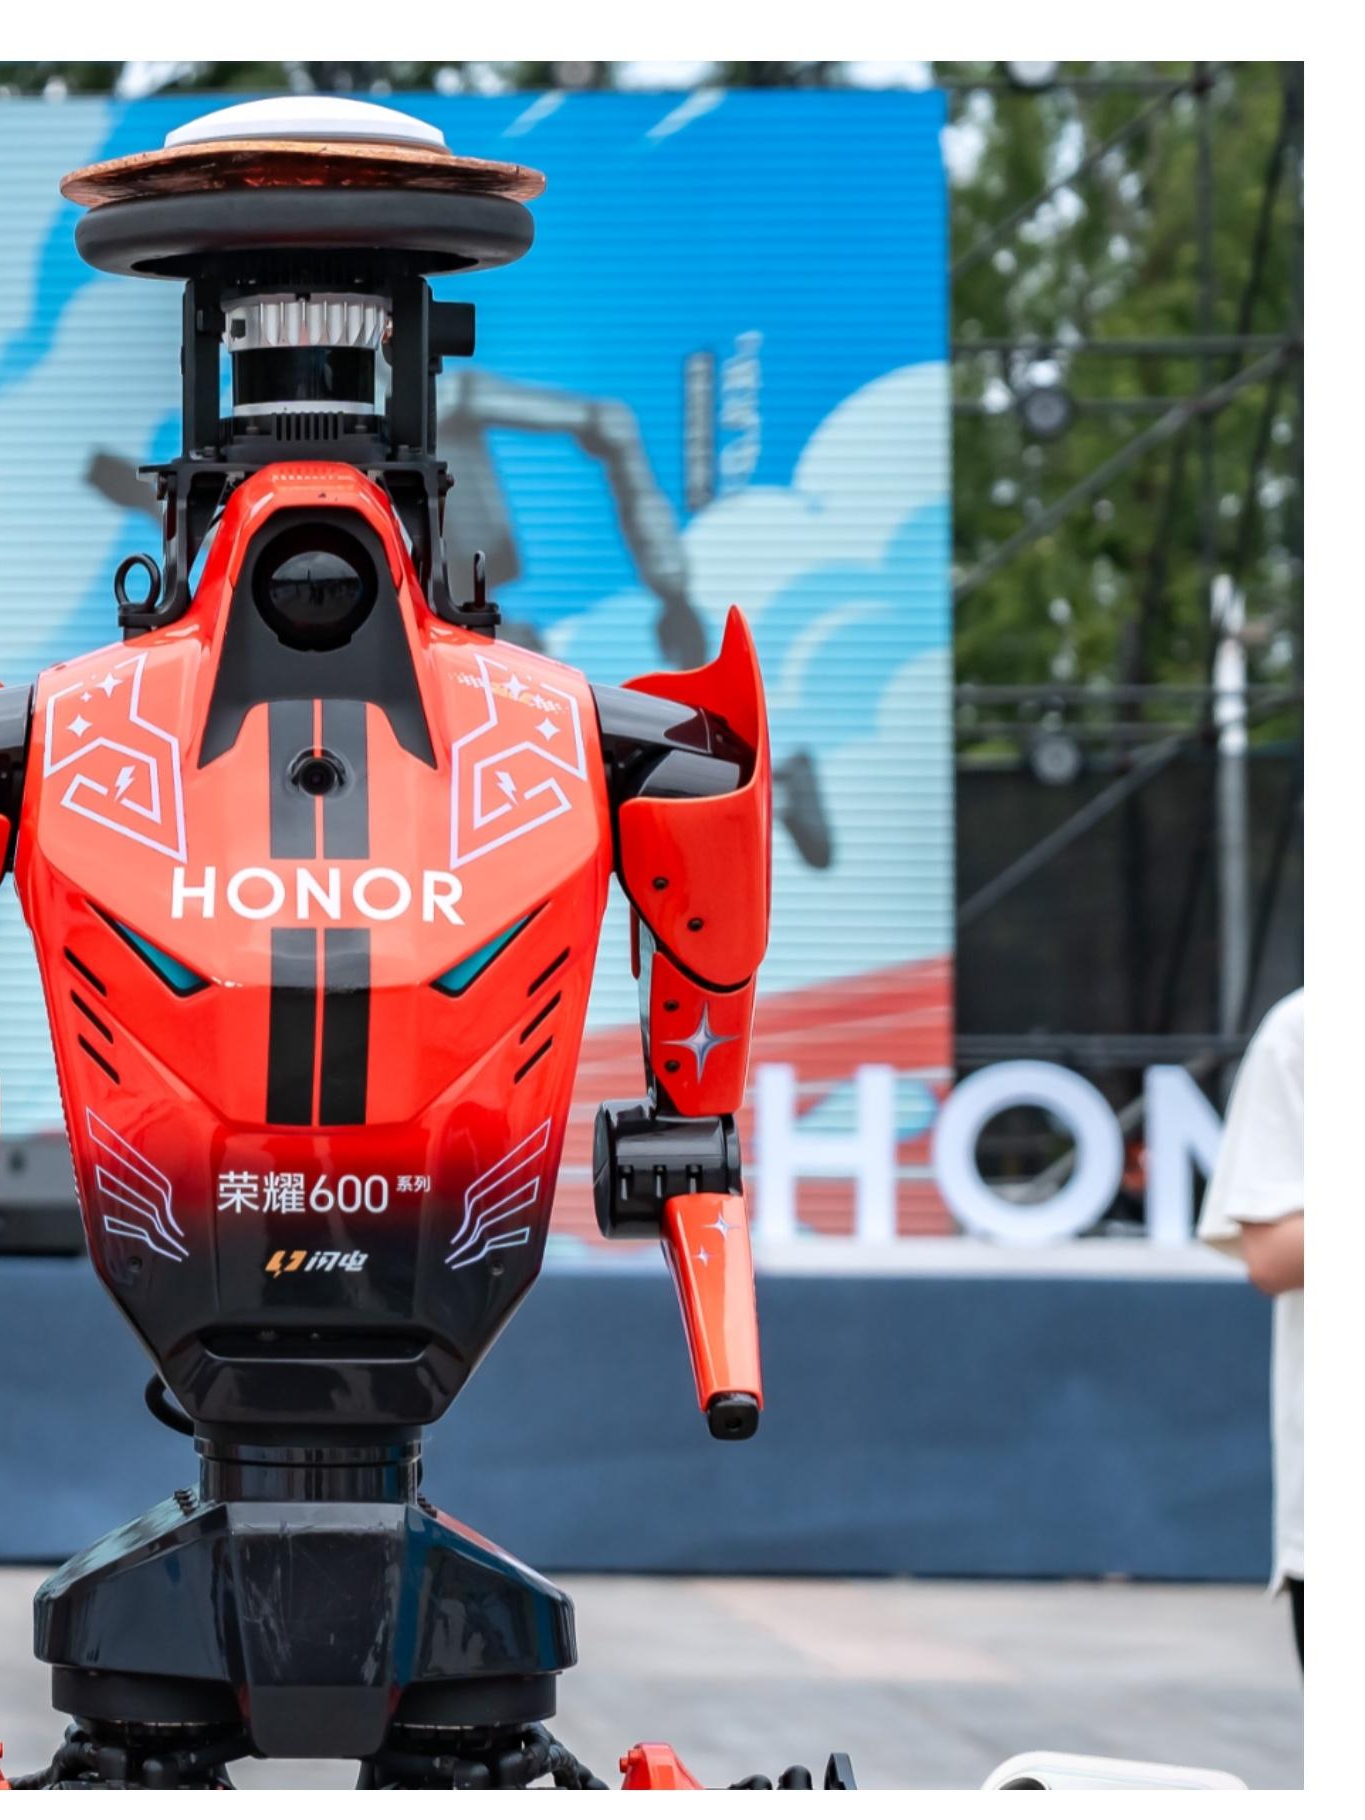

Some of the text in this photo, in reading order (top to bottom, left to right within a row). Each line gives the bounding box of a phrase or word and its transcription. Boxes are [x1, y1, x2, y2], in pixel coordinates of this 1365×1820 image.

[170, 866, 466, 926] HONOR
[216, 1169, 431, 1217] 荣耀600 系列
[302, 1247, 367, 1272] 闪电
